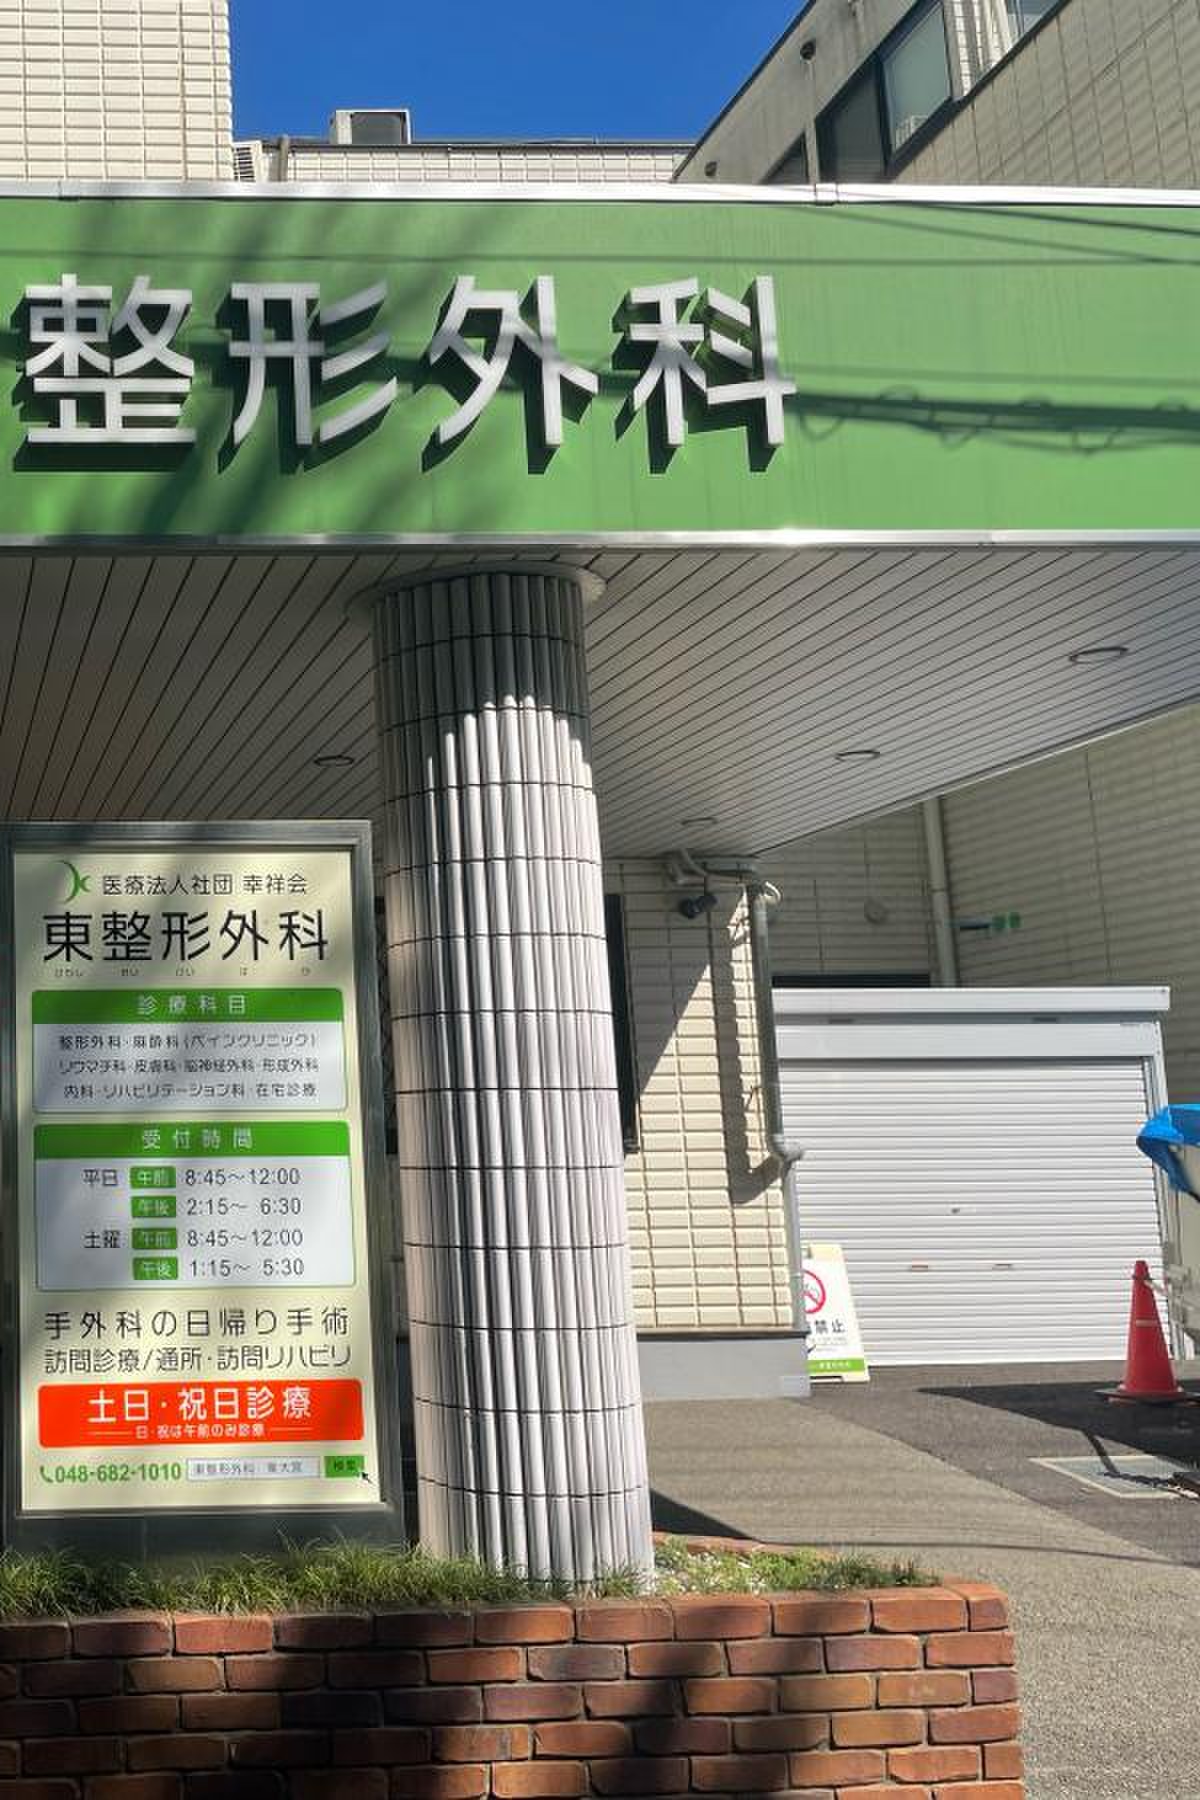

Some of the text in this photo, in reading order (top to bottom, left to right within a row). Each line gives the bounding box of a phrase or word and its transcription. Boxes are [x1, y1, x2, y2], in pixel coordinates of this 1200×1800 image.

[102, 873, 308, 896] 医療法人社団 幸祥会
[42, 909, 329, 962] 東整形外科
[137, 994, 246, 1015] 診療科目
[141, 1128, 254, 1150] 受付時間
[82, 1168, 119, 1187] 平日
[137, 1170, 169, 1185] 午前
[259, 1196, 302, 1215] 6:30
[84, 1230, 122, 1249] 土曜
[262, 1258, 305, 1276] 5:30
[43, 1308, 350, 1341] 手外科の日帰り手術
[87, 1385, 314, 1424] 土日・祝日診療
[54, 1463, 182, 1484] 048-682-1010
